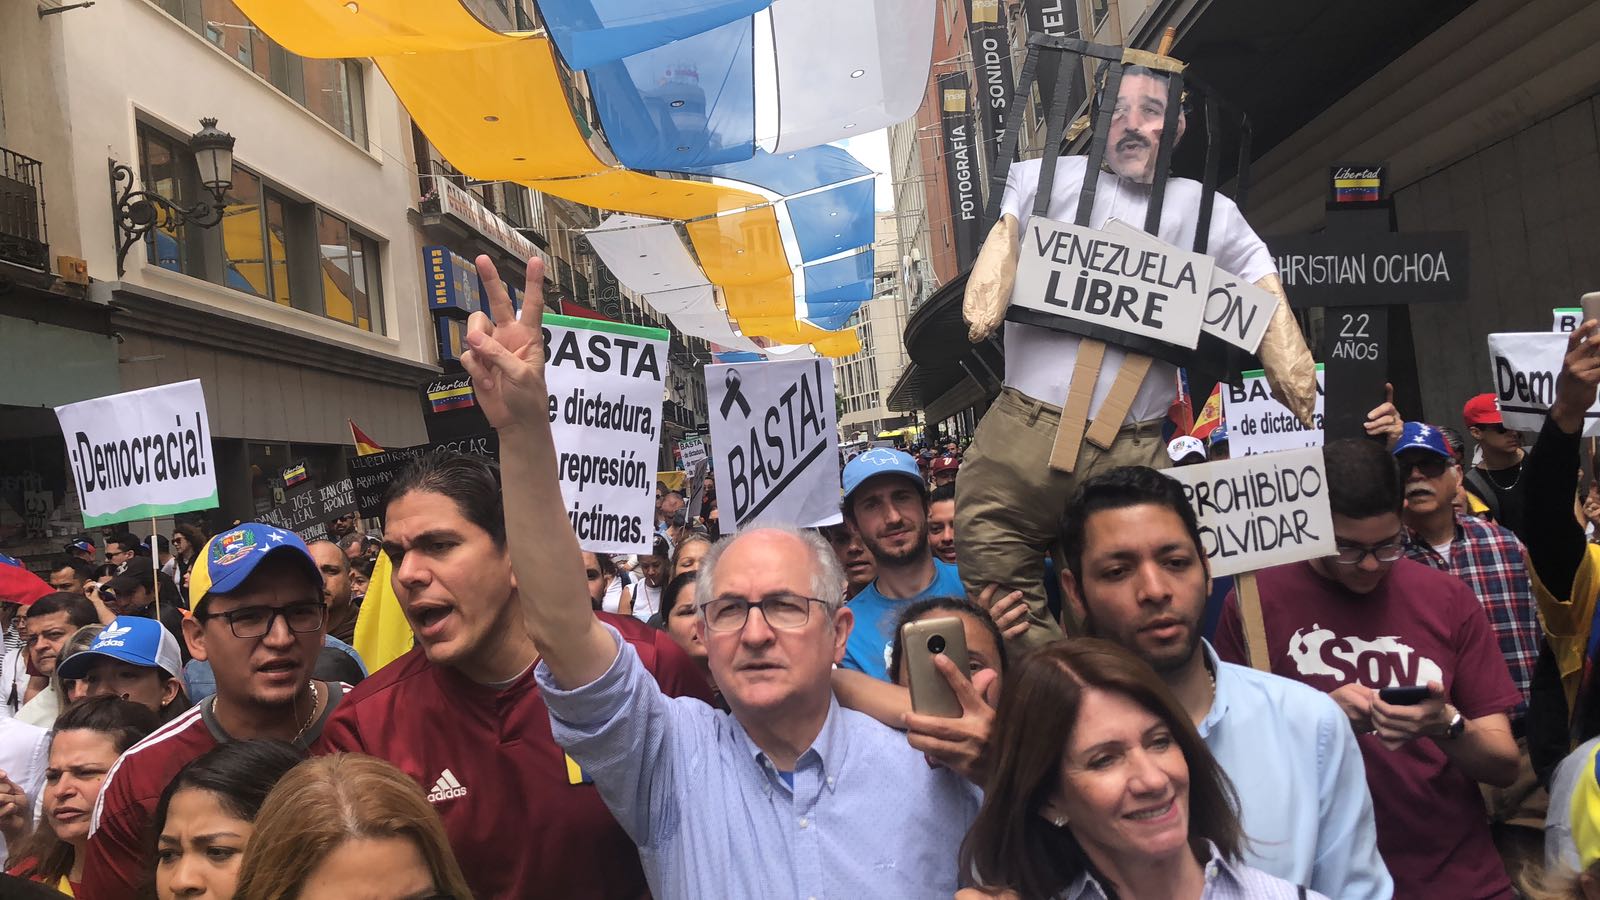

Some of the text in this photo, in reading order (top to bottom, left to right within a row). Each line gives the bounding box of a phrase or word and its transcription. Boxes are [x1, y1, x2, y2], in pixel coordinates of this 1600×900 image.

[983, 38, 1006, 109] SONIDO
[950, 125, 976, 221] FOTOGRAFÍA
[1334, 167, 1381, 180] Libertad
[1034, 226, 1197, 294] VENEZUELA
[1272, 251, 1451, 286] HRISTIAN OCHOA
[1044, 270, 1169, 330] LIBRE
[1203, 282, 1258, 340] ÓN
[1339, 313, 1370, 338] 22
[1331, 339, 1379, 361] AÑOS
[426, 375, 473, 394] Libertad
[1496, 356, 1561, 405] Dem
[548, 388, 655, 442] e dictadura,
[1241, 414, 1257, 436] de
[1260, 411, 1324, 434] dictadra
[72, 411, 206, 511] ¡Democracia!
[728, 360, 827, 523] BASTA!
[558, 450, 651, 497] represión,
[1182, 464, 1321, 517] PROHIBIDO
[291, 489, 316, 512] JOSE
[293, 507, 317, 525] LEAL
[323, 490, 356, 514] APONTE
[568, 501, 646, 544] ictimas.
[1198, 509, 1320, 560] OLVIDAR
[427, 786, 467, 803] adidas
